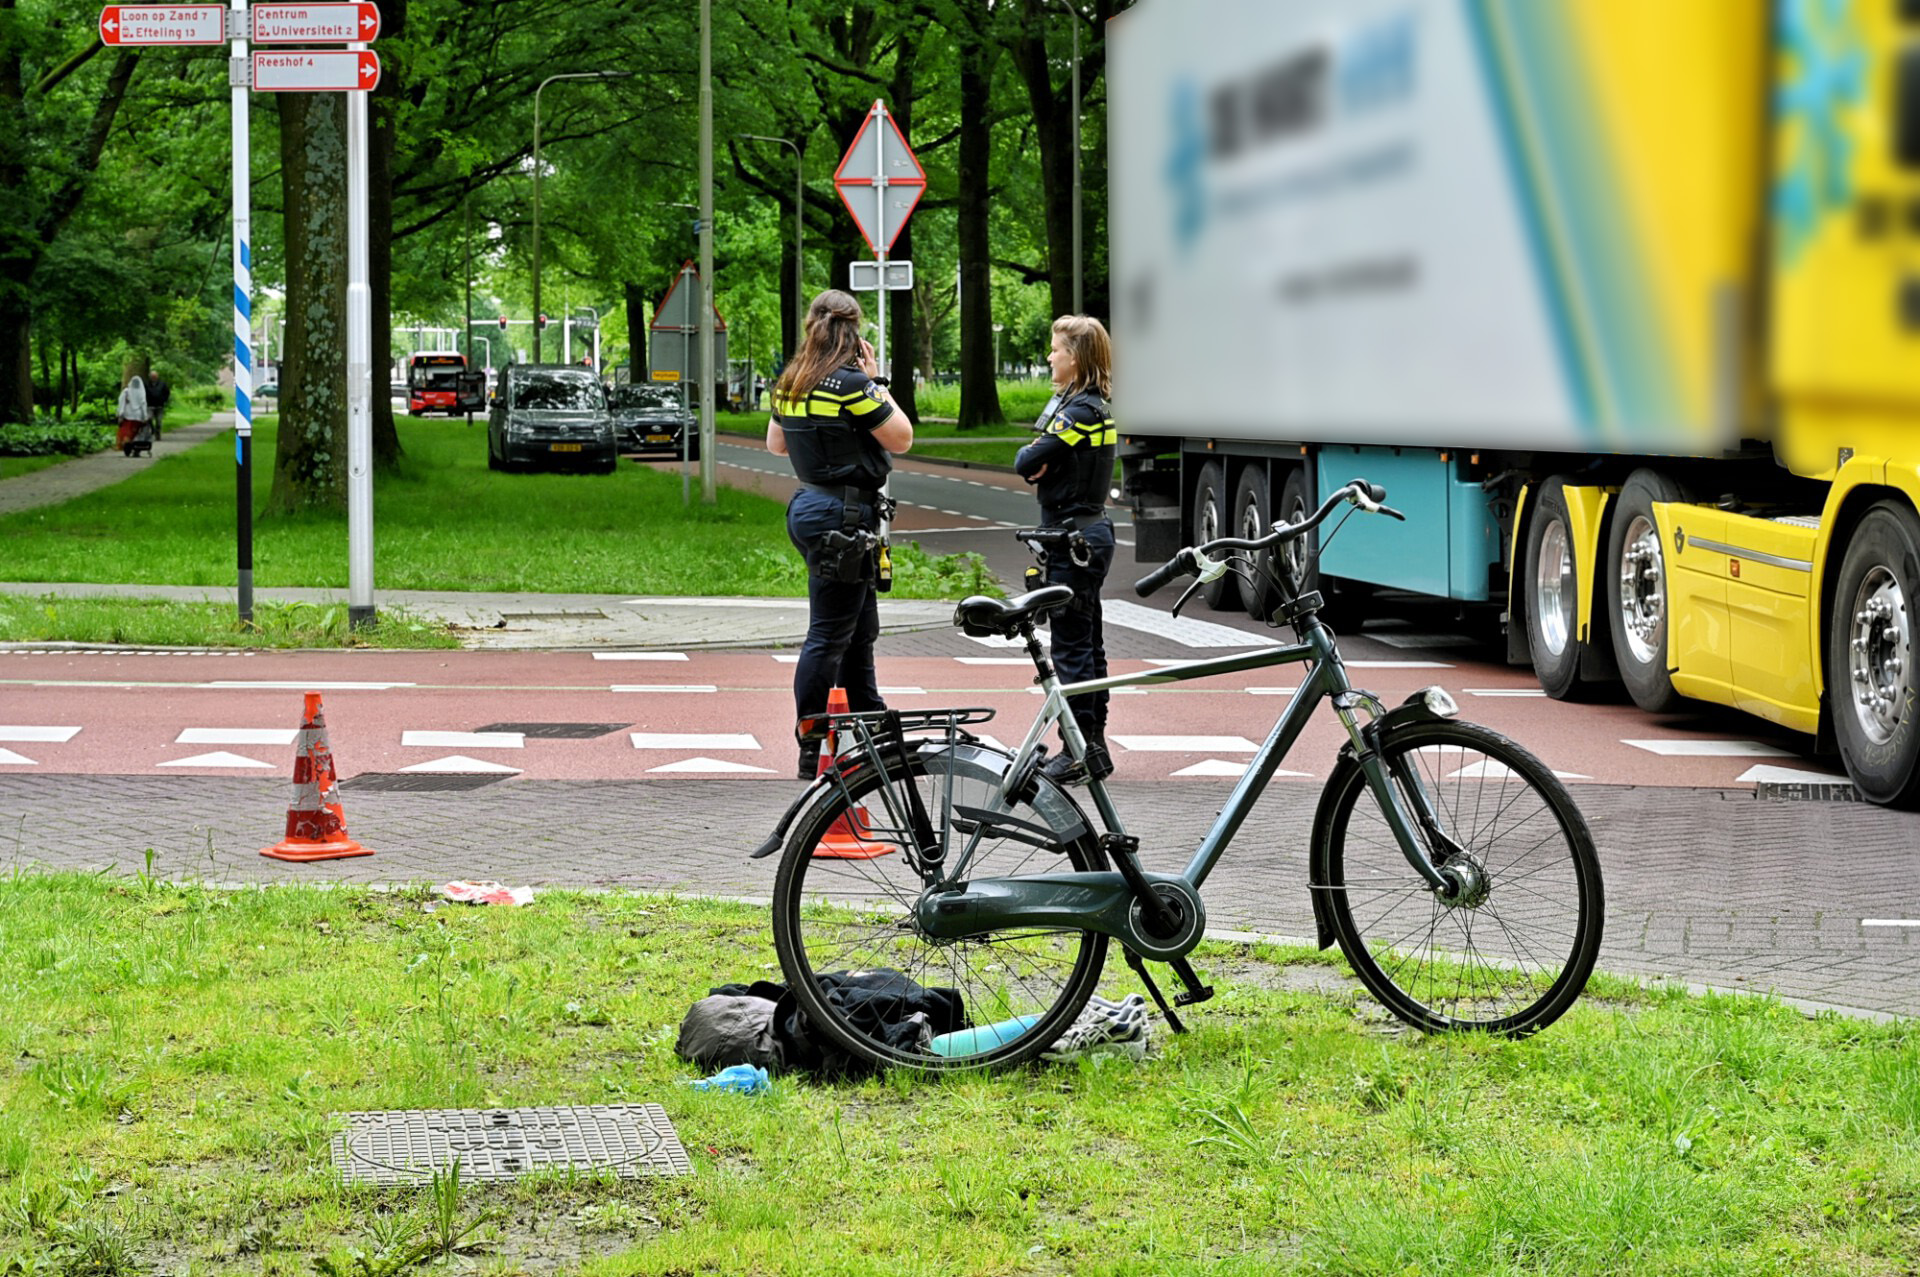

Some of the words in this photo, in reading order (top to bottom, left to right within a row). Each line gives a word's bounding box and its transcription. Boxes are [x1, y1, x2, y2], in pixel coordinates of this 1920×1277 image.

[122, 11, 148, 21] Loon
[152, 13, 165, 22] op
[169, 10, 199, 21] Zand
[202, 12, 208, 20] 7
[258, 9, 308, 19] Centrum
[136, 27, 182, 39] Efteling
[186, 29, 196, 37] 13
[272, 25, 342, 36] Universiteit
[346, 27, 352, 35] 2
[258, 57, 304, 67] Reeshof
[307, 58, 314, 67] 4
